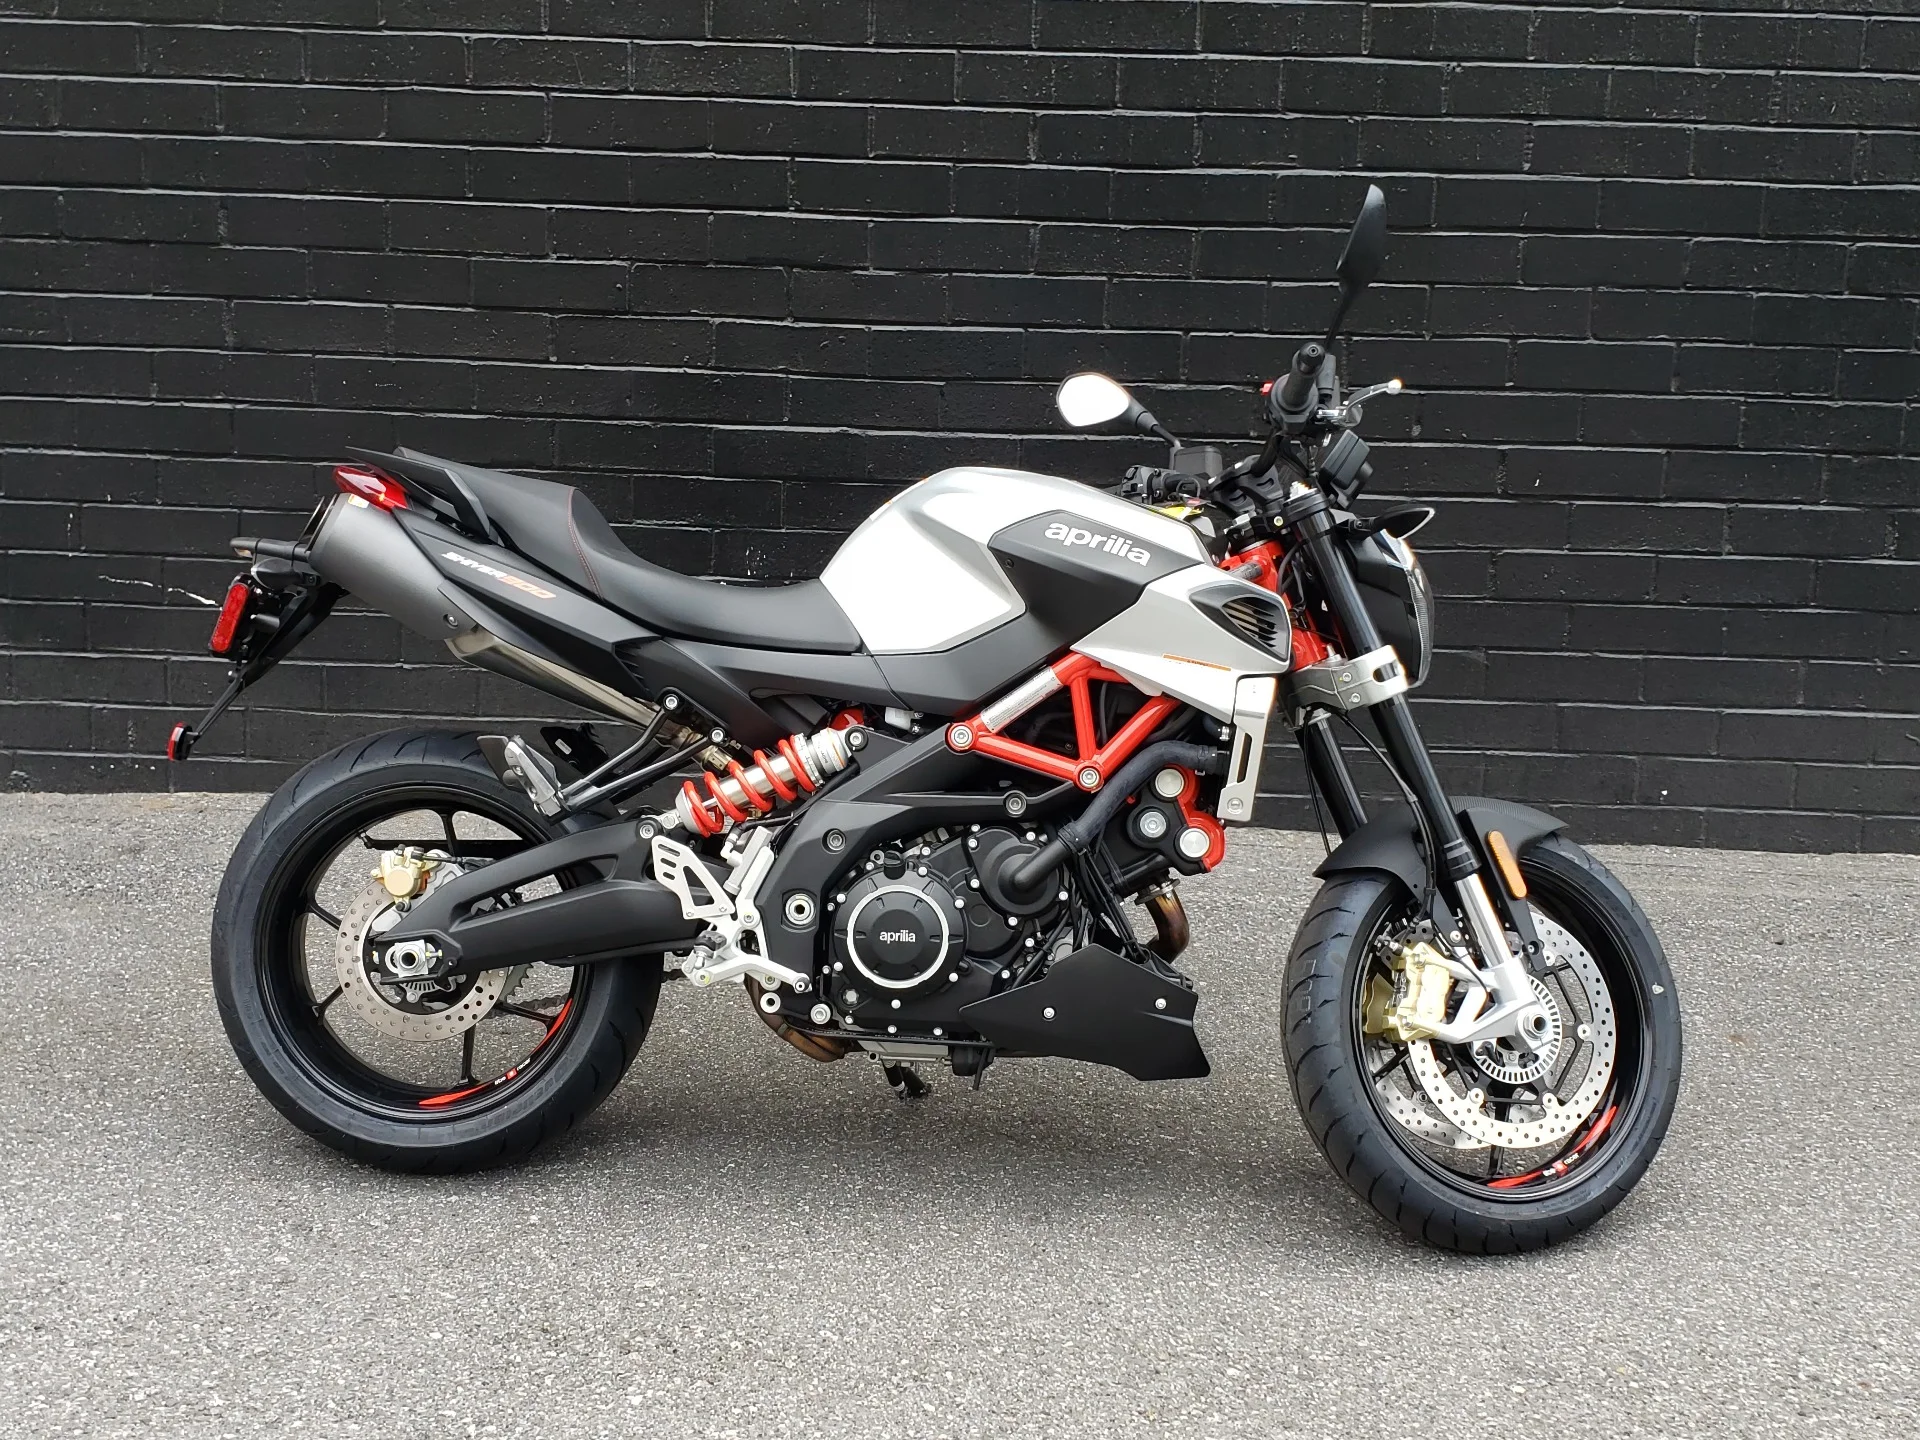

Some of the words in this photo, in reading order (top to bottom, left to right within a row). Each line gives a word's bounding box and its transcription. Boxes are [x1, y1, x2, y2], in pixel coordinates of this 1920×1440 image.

[1044, 522, 1151, 567] aprilia
[441, 551, 508, 579] SHIVER
[879, 929, 916, 944] aprilia
